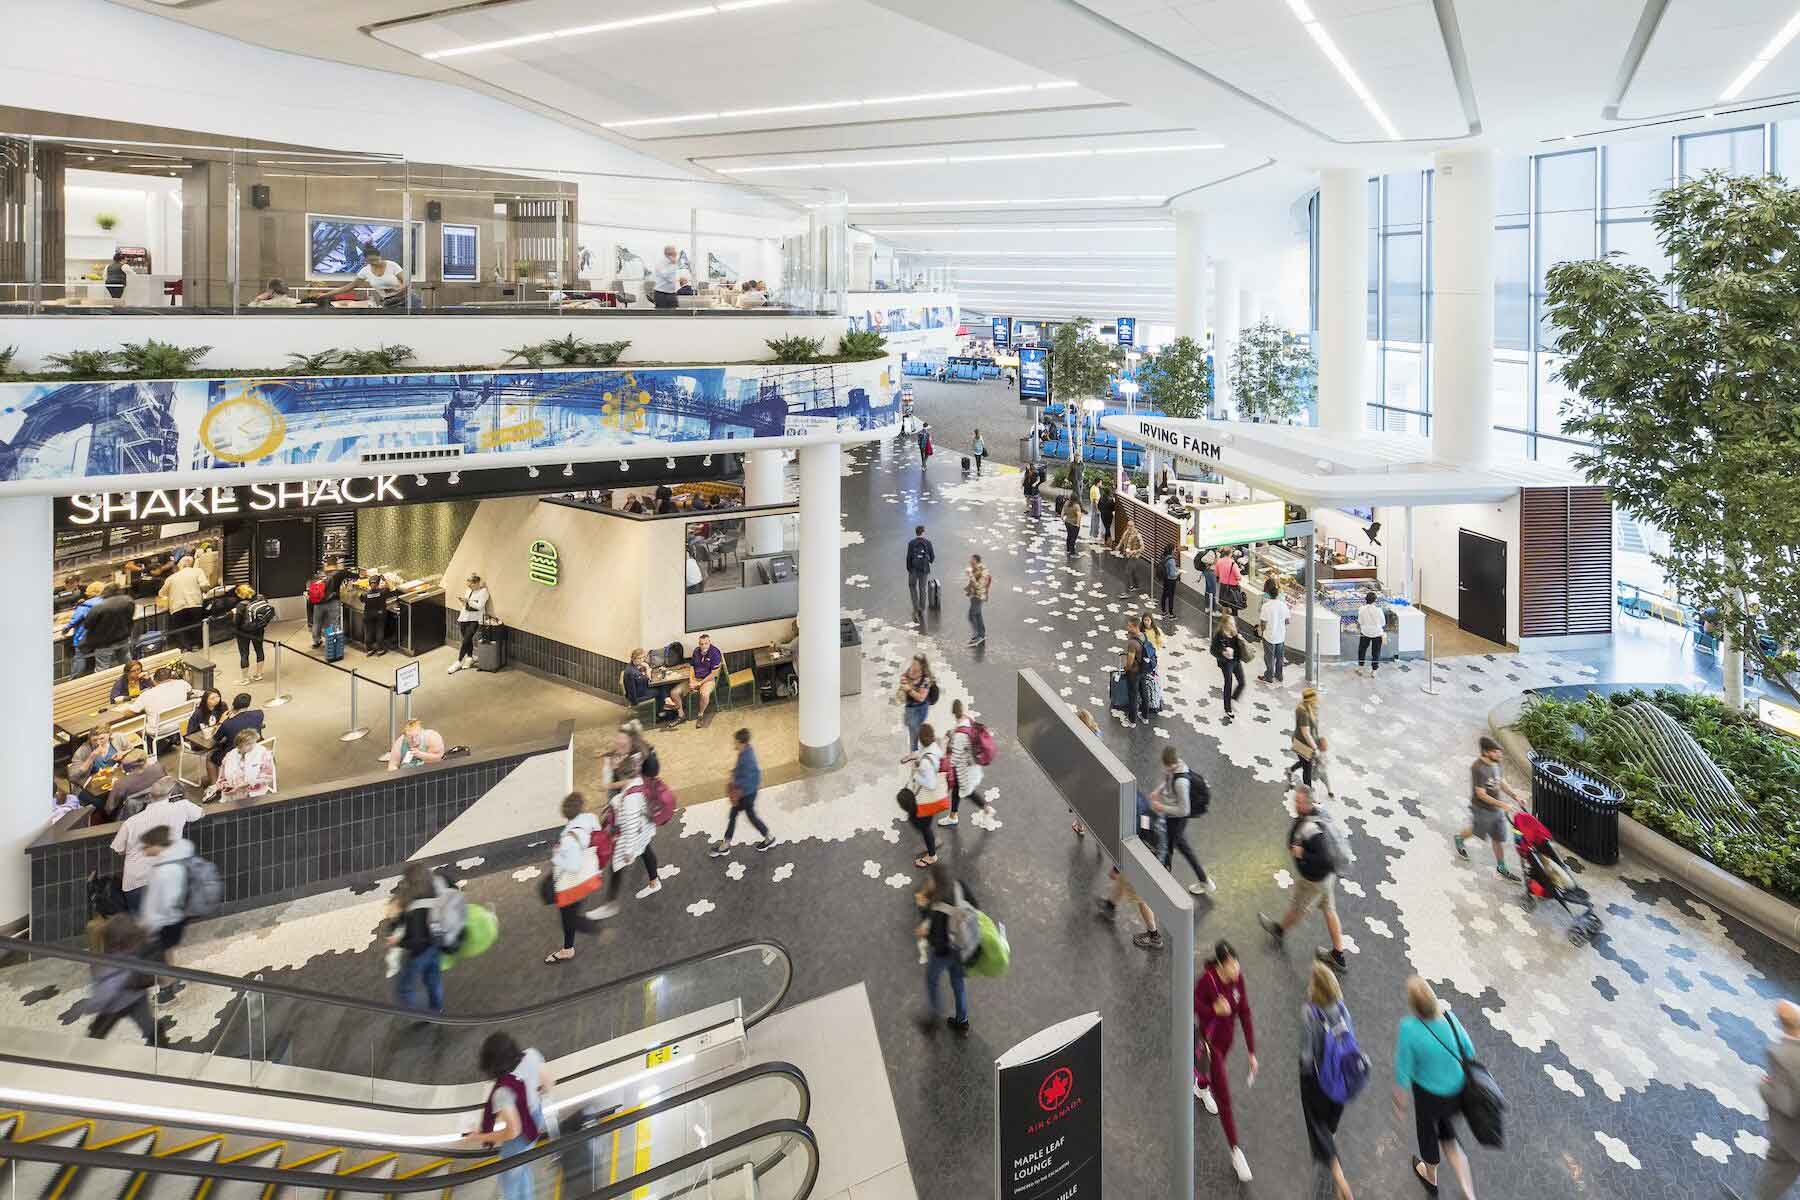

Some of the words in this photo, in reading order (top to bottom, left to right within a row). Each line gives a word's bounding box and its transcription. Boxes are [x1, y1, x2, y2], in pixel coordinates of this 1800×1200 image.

[1140, 421, 1178, 445] IRVING
[1183, 435, 1220, 461] FARM
[68, 486, 239, 525] SHAKE
[249, 474, 403, 511] SHACK
[1014, 1149, 1043, 1168] MAPLE
[1046, 1136, 1065, 1155] LEAF
[1014, 1156, 1052, 1181] LOUNGE
